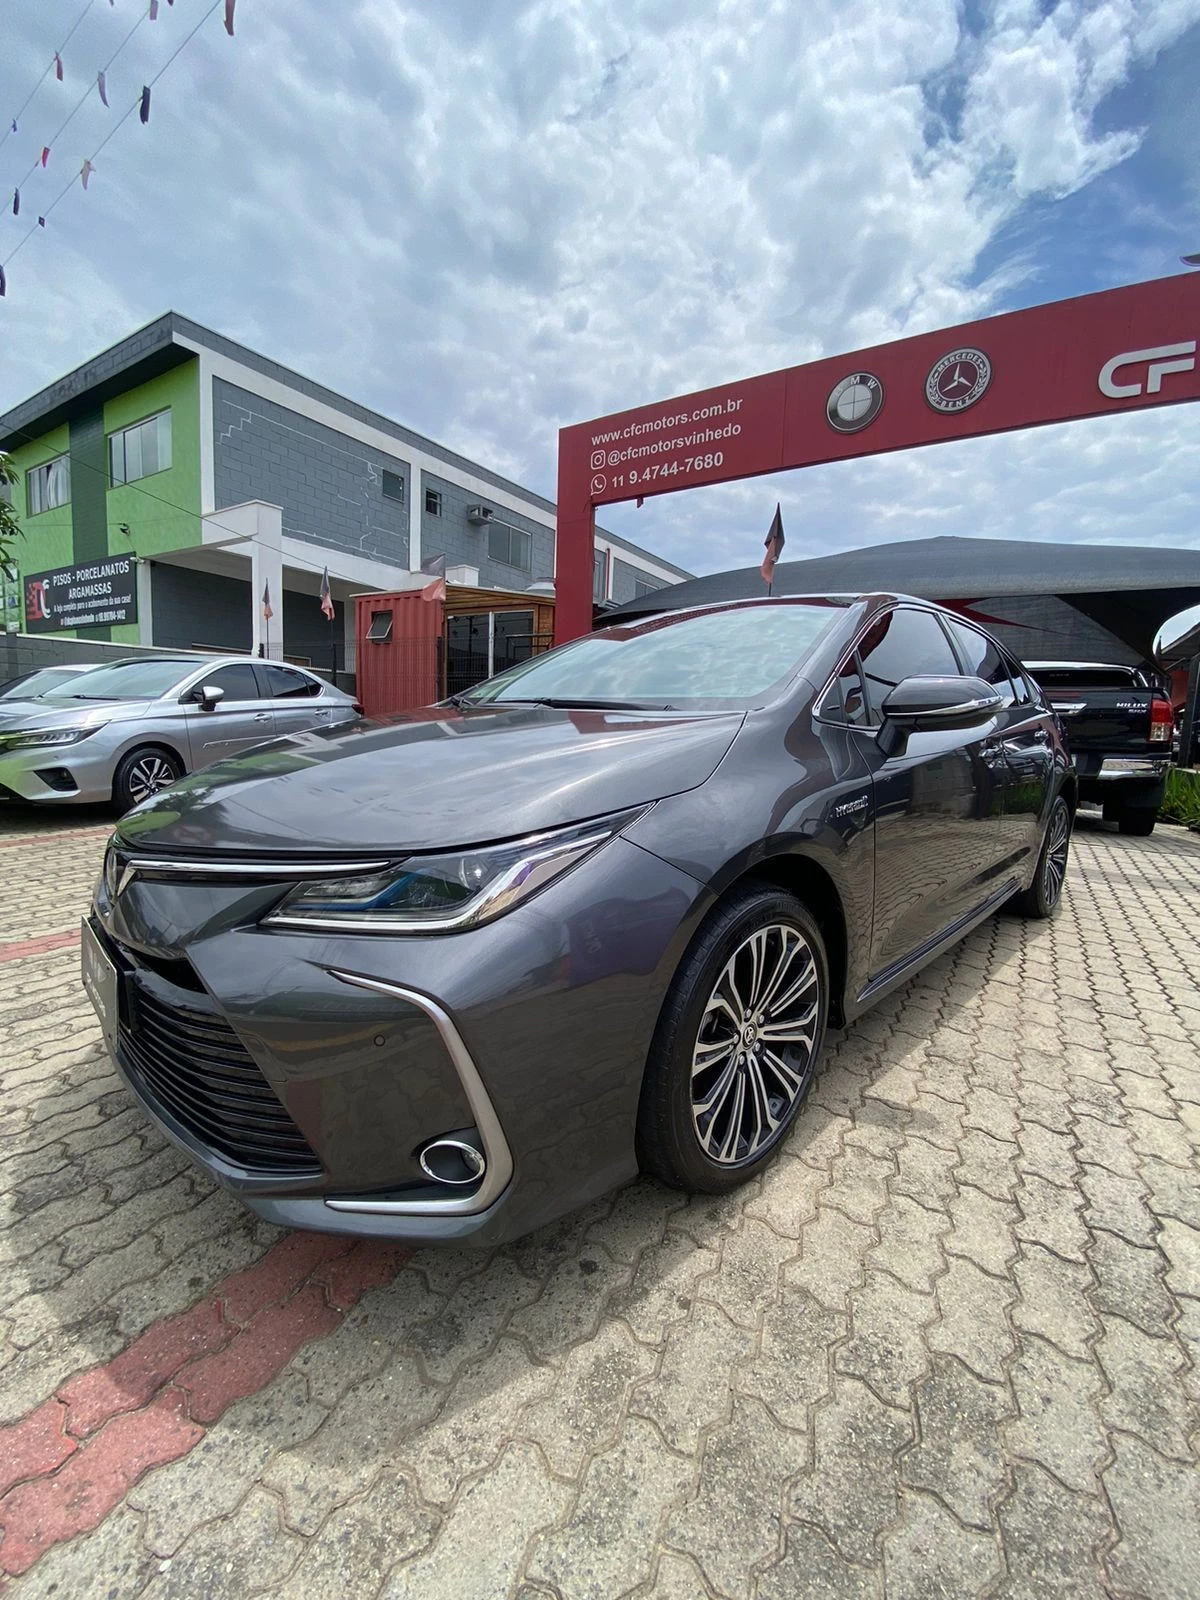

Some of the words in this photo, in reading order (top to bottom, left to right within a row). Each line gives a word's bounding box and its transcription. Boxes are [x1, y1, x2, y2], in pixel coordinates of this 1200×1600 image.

[937, 352, 983, 372] MERCEDES
[591, 398, 743, 446] www.cfcmotors.com.br
[607, 423, 742, 466] @cfcmotorsvinhedo
[611, 475, 624, 488] 11
[629, 451, 724, 485] 9.4744-7680
[53, 573, 72, 587] PISOS
[76, 560, 130, 582] PORCELANATOS
[68, 581, 112, 600] ARGAMASSAS
